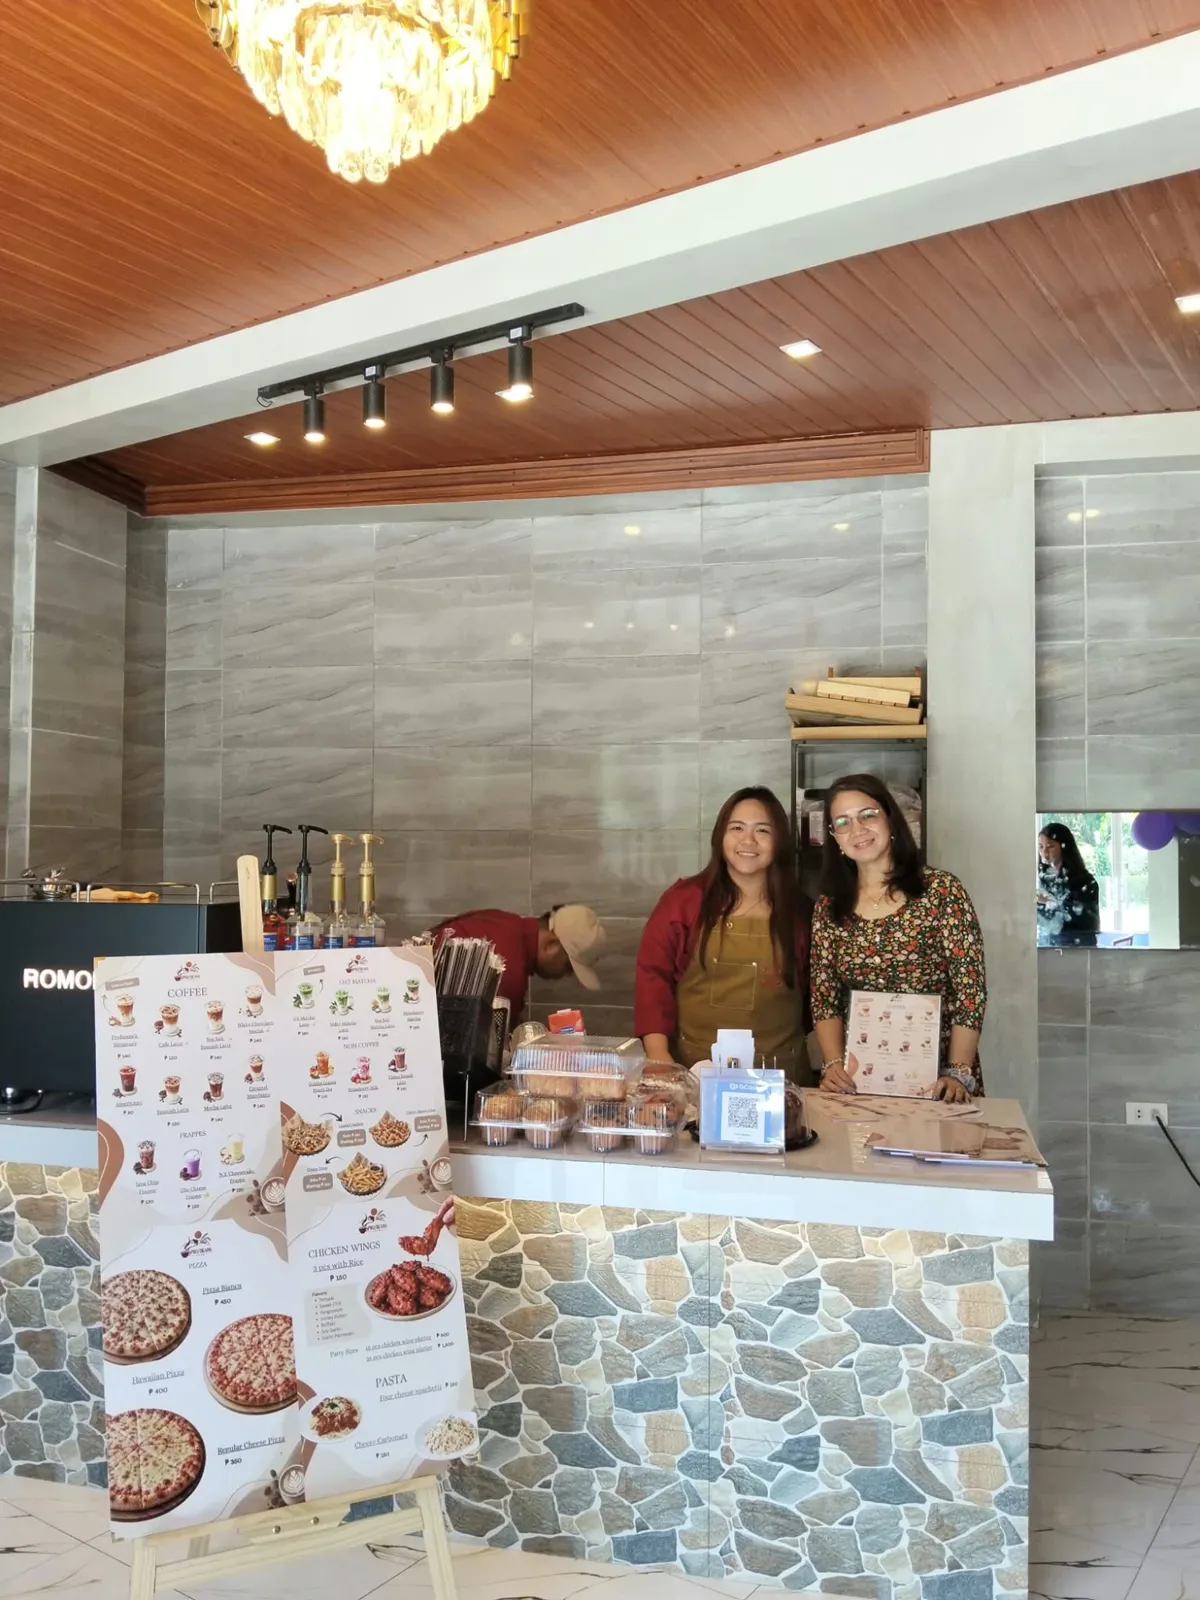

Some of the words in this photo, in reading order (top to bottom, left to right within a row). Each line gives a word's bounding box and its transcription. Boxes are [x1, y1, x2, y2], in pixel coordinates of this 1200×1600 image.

[167, 987, 208, 998] COFFEE
[354, 1107, 377, 1115] SNACKS
[179, 1130, 207, 1139] FRAPPES
[308, 1245, 349, 1259] CHICKEN
[350, 1240, 381, 1254] WINGS
[188, 1261, 208, 1269] PIZZA
[318, 1264, 331, 1273] pcs
[331, 1261, 348, 1270] with
[348, 1259, 364, 1269] Rice
[202, 1287, 220, 1295] Pizza
[381, 1340, 401, 1350] chicken
[330, 1350, 344, 1358] Party
[383, 1350, 402, 1360] chicken
[132, 1372, 165, 1385] Hawaiian
[166, 1369, 185, 1380] Pizza
[375, 1373, 408, 1389] PASTA
[380, 1394, 393, 1403] Four
[394, 1390, 414, 1400] cheese
[217, 1443, 243, 1456] Regular
[244, 1440, 267, 1451] Cheese
[268, 1436, 286, 1446] Pizza
[230, 1457, 243, 1465] 350
